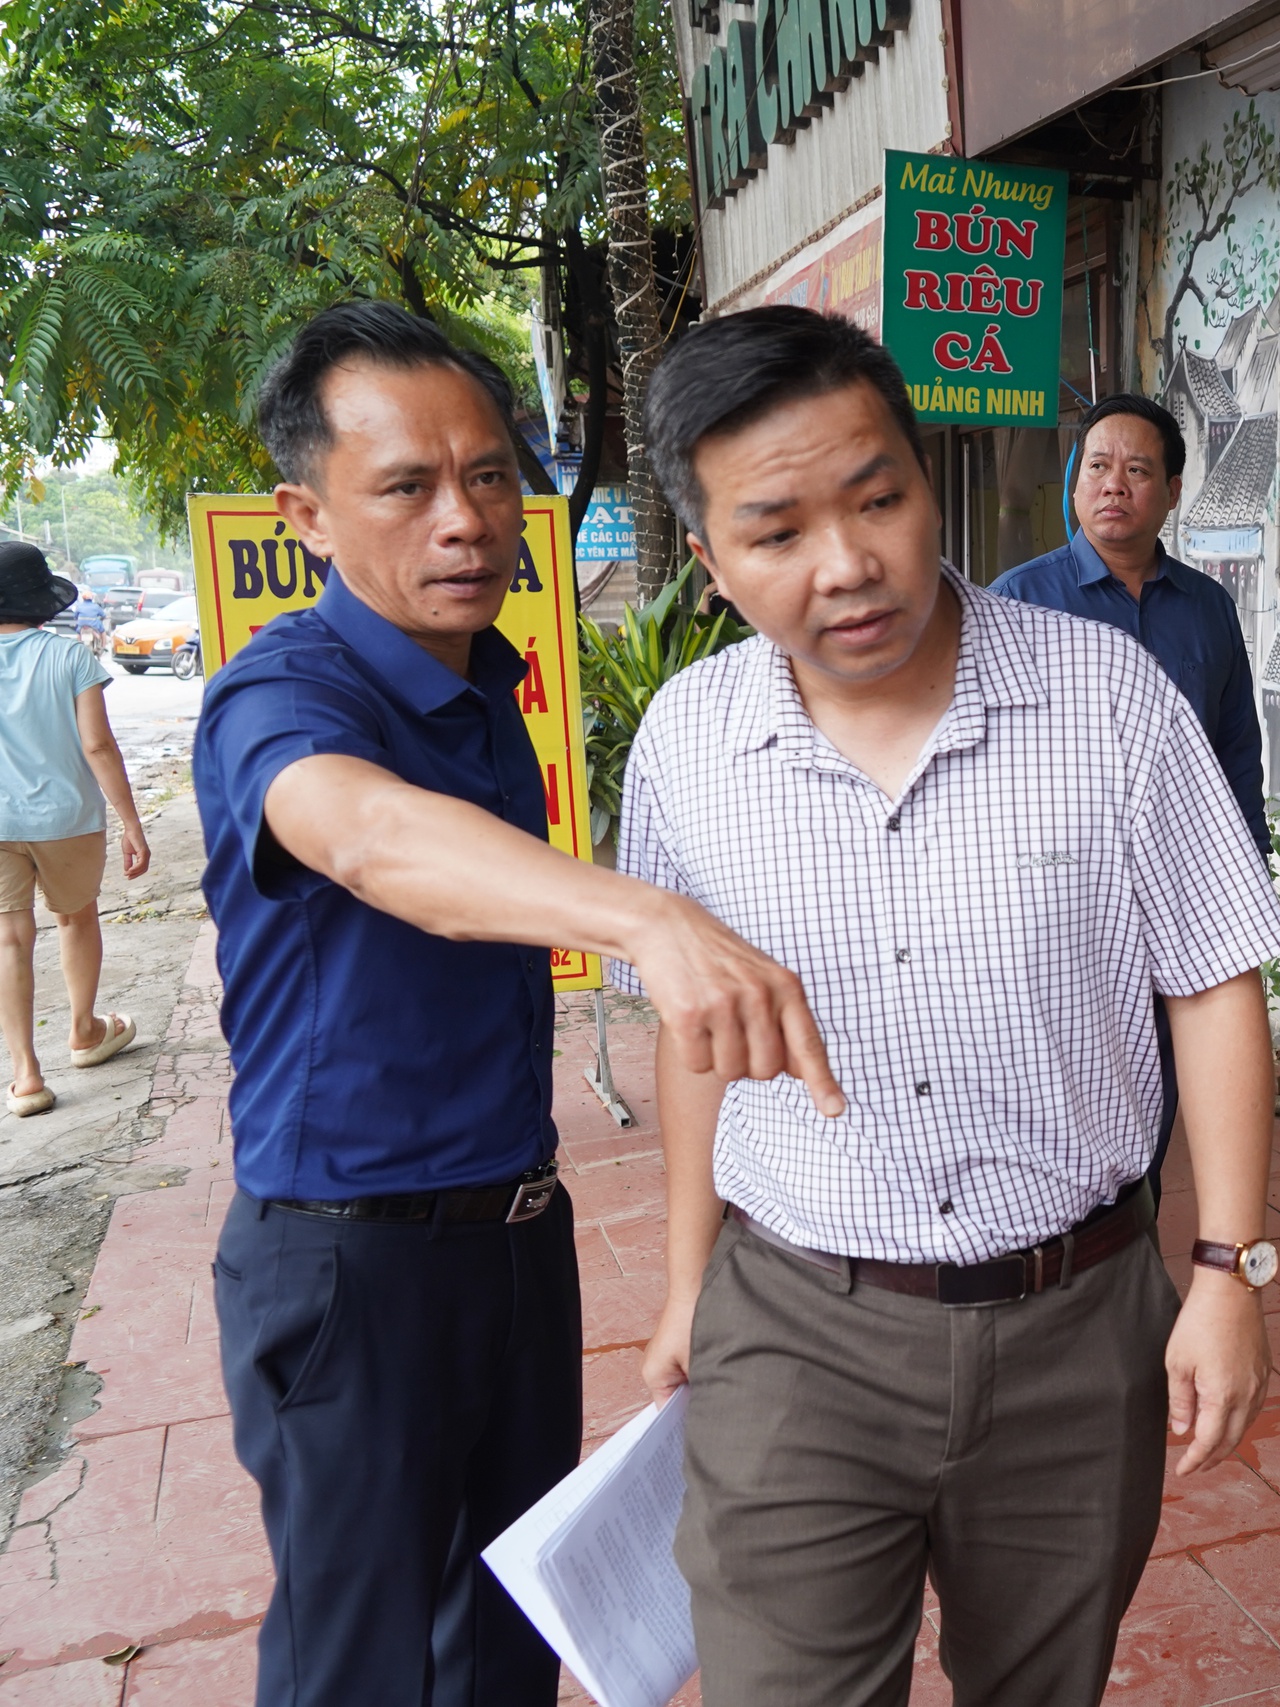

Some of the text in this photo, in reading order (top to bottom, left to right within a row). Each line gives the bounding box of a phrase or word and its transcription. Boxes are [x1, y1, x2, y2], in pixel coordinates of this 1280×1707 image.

[900, 162, 1055, 211] Mai Nhung
[913, 203, 1038, 260] BÚN
[902, 263, 1045, 318] RIÊU
[932, 323, 1014, 374] CÁ
[986, 388, 1045, 417] NINH
[587, 546, 605, 557] YÊN
[607, 547, 619, 557] XE
[591, 529, 613, 543] CÁC
